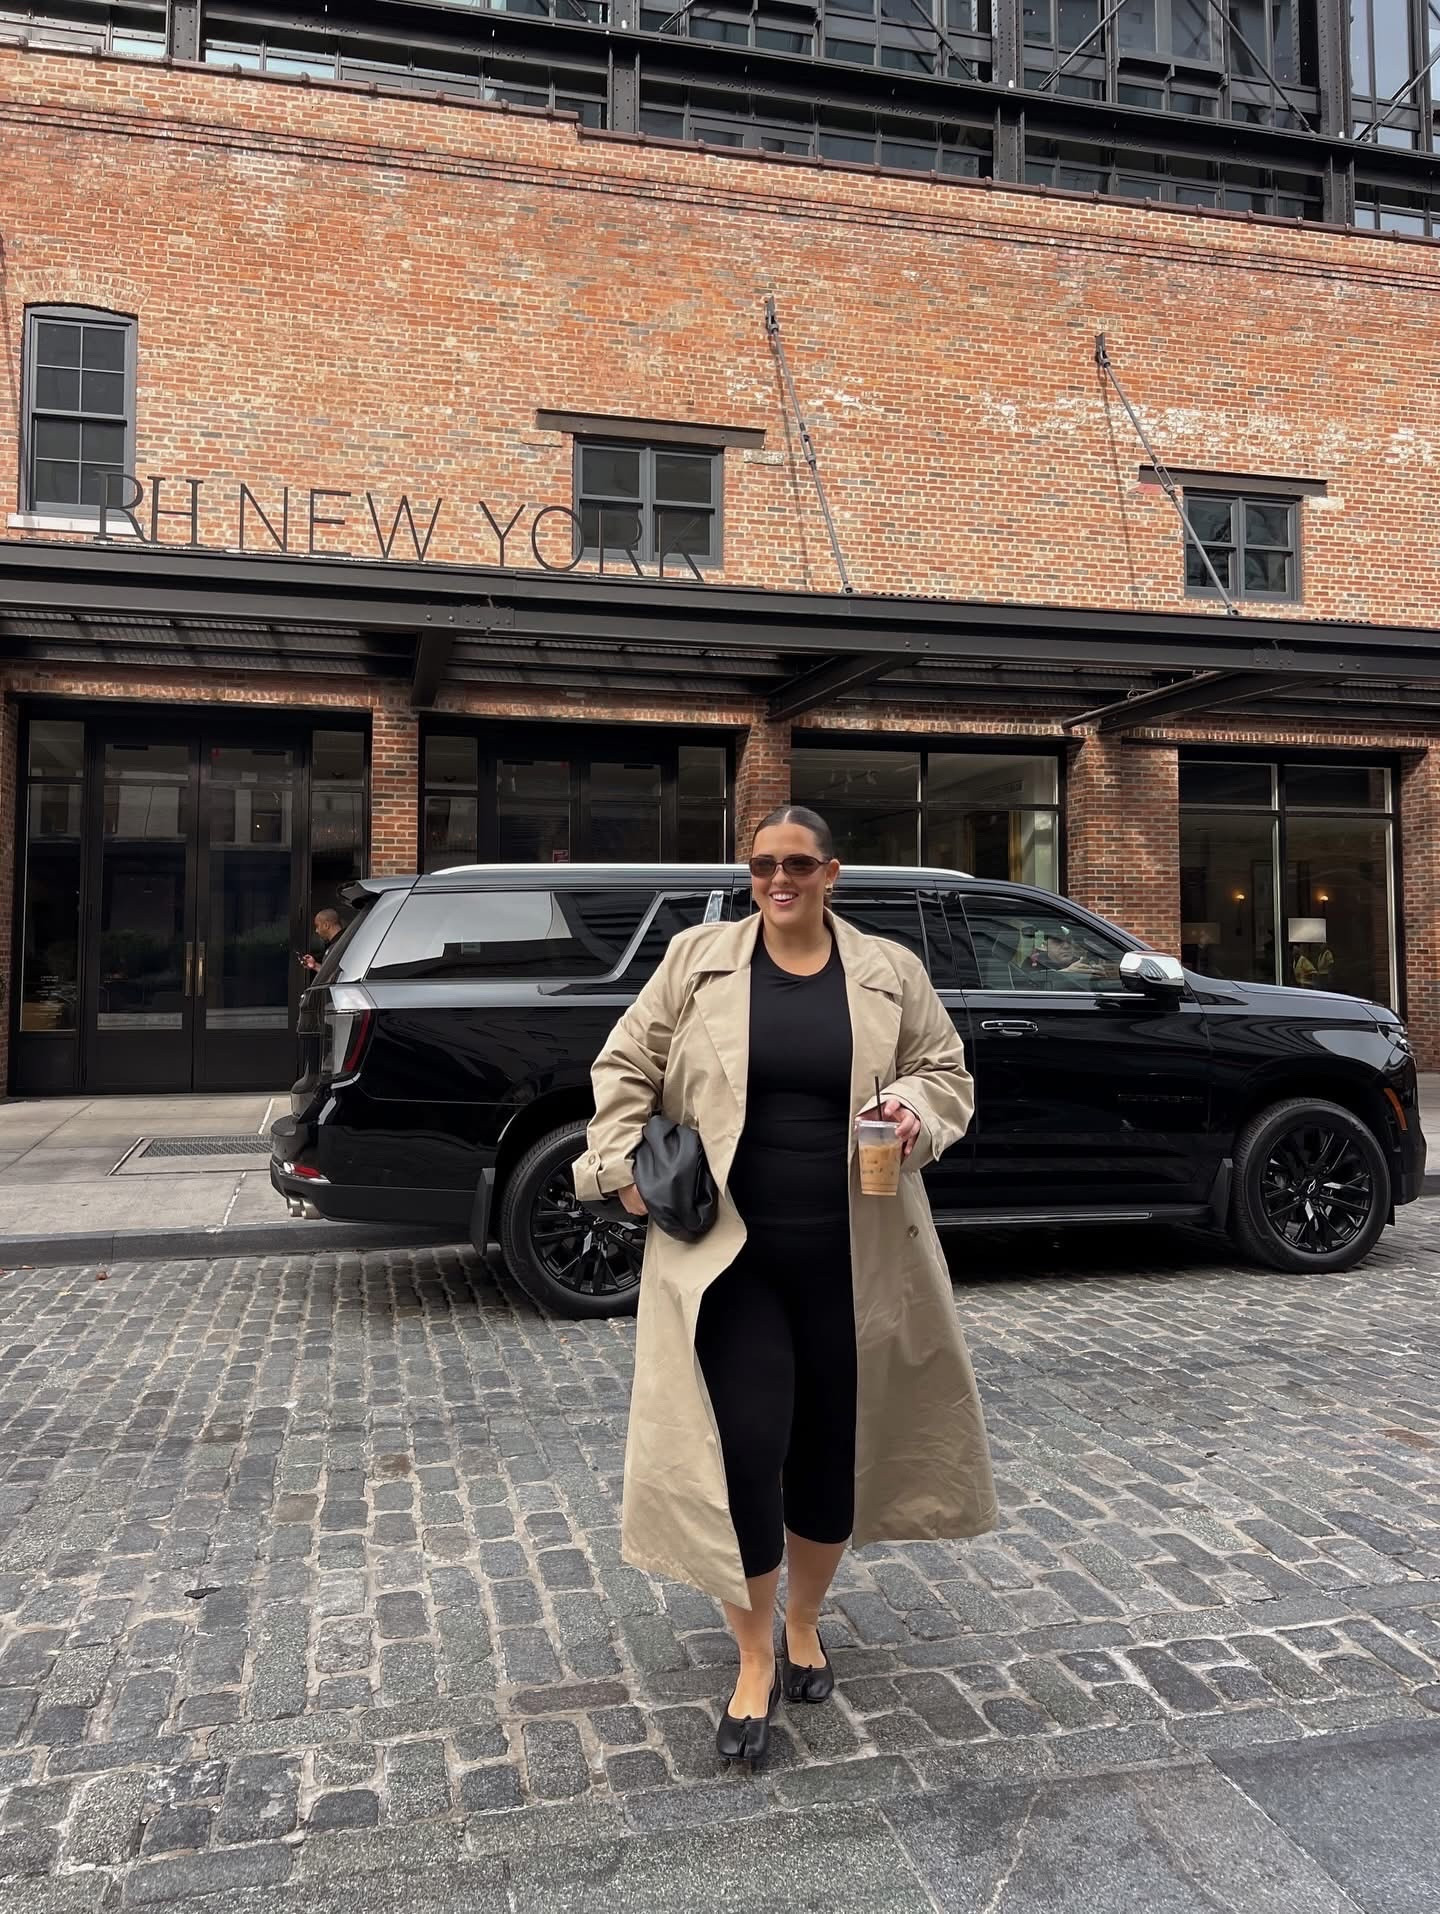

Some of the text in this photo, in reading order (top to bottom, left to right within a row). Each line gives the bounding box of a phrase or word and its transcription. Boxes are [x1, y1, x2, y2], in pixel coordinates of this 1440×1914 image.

[93, 470, 705, 582] RH NEW YORK
